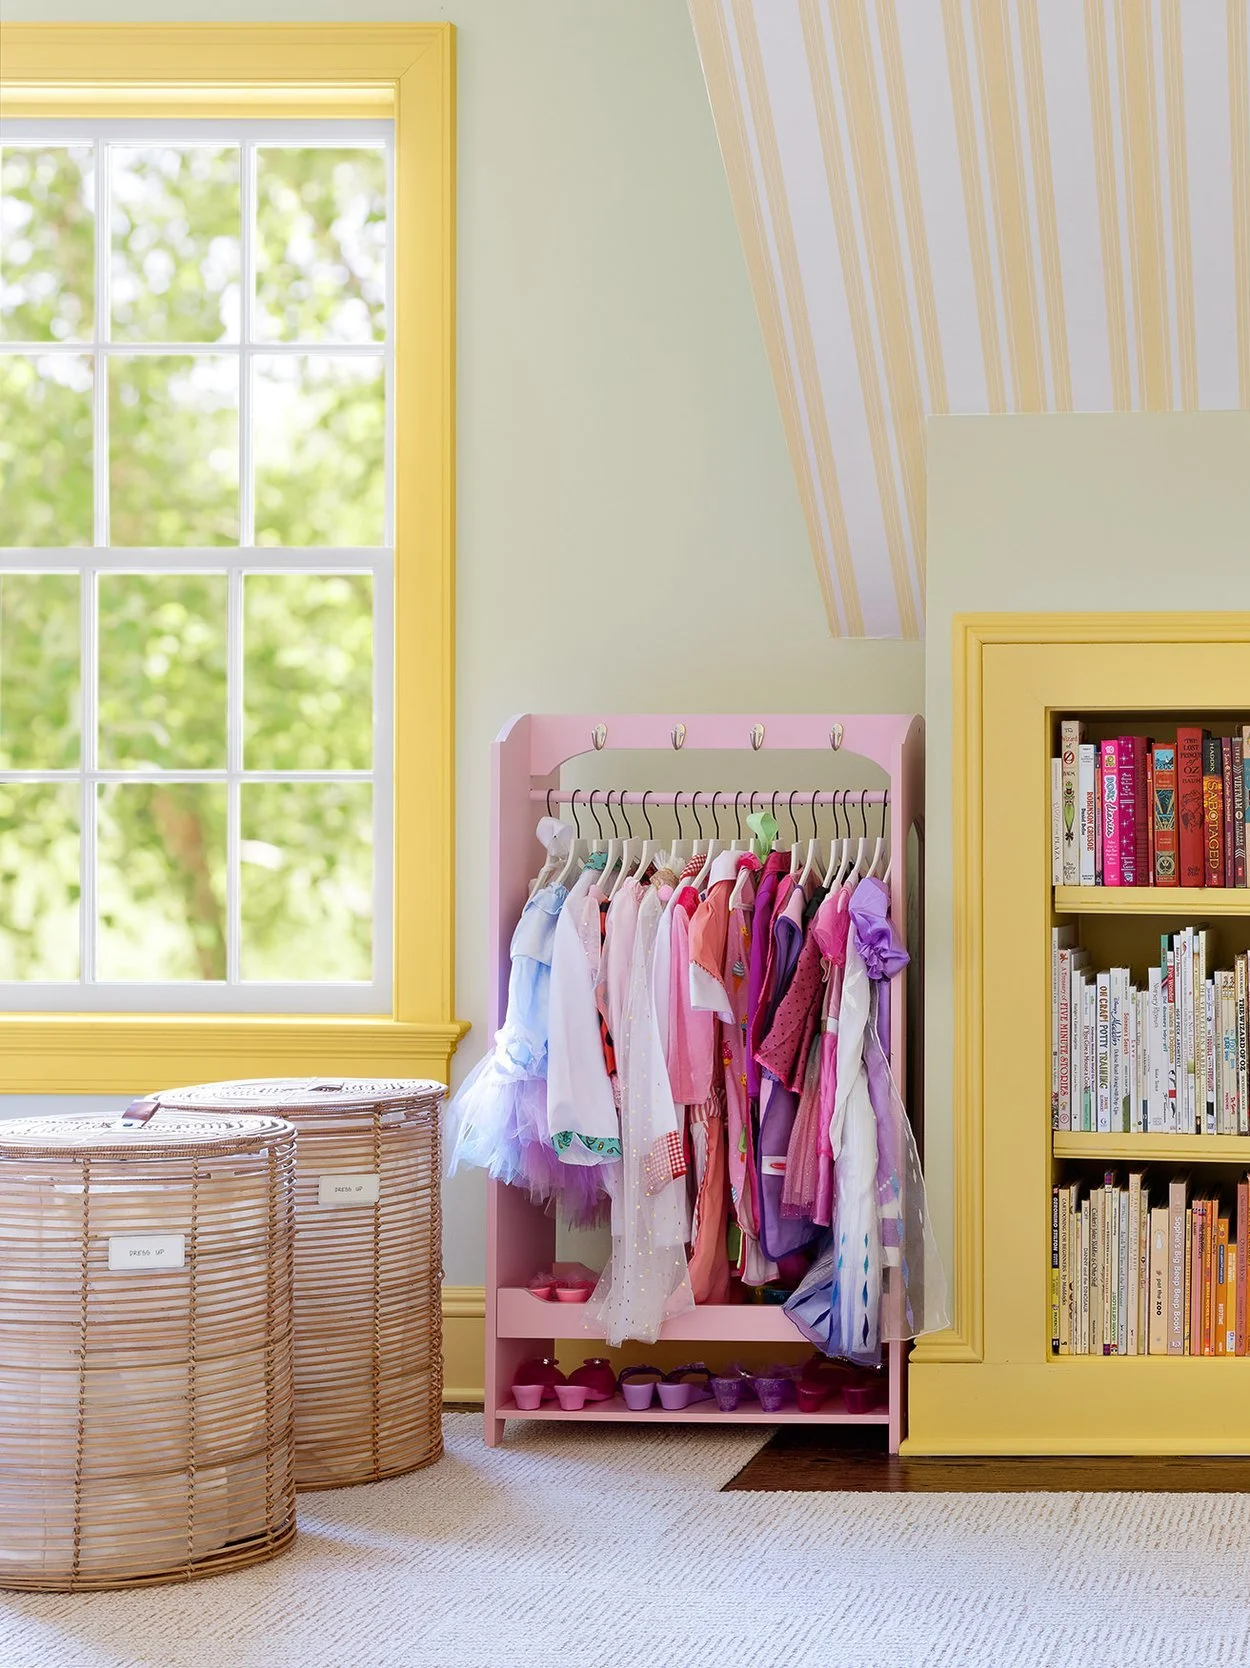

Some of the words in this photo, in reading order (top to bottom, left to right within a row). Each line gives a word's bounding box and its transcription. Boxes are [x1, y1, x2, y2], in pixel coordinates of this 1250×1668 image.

[1184, 766, 1200, 774] OZ
[1234, 775, 1242, 809] VIETNAM
[1086, 791, 1094, 824] ROBINSON
[1207, 781, 1219, 869] SABOTAGED
[1060, 1002, 1068, 1021] FIVE
[1099, 998, 1108, 1022] CRAP!
[1060, 1023, 1068, 1055] MINUTE
[1099, 1025, 1108, 1048] POTTY
[1060, 1056, 1068, 1096] STORIES
[1099, 1051, 1108, 1089] TRAINING
[1240, 1060, 1246, 1072] OZ
[1172, 1216, 1182, 1249] Sophie's
[1172, 1251, 1181, 1263] Big
[1172, 1266, 1181, 1285] Beep
[1172, 1287, 1181, 1308] Beep
[1173, 1310, 1181, 1334] Book!
